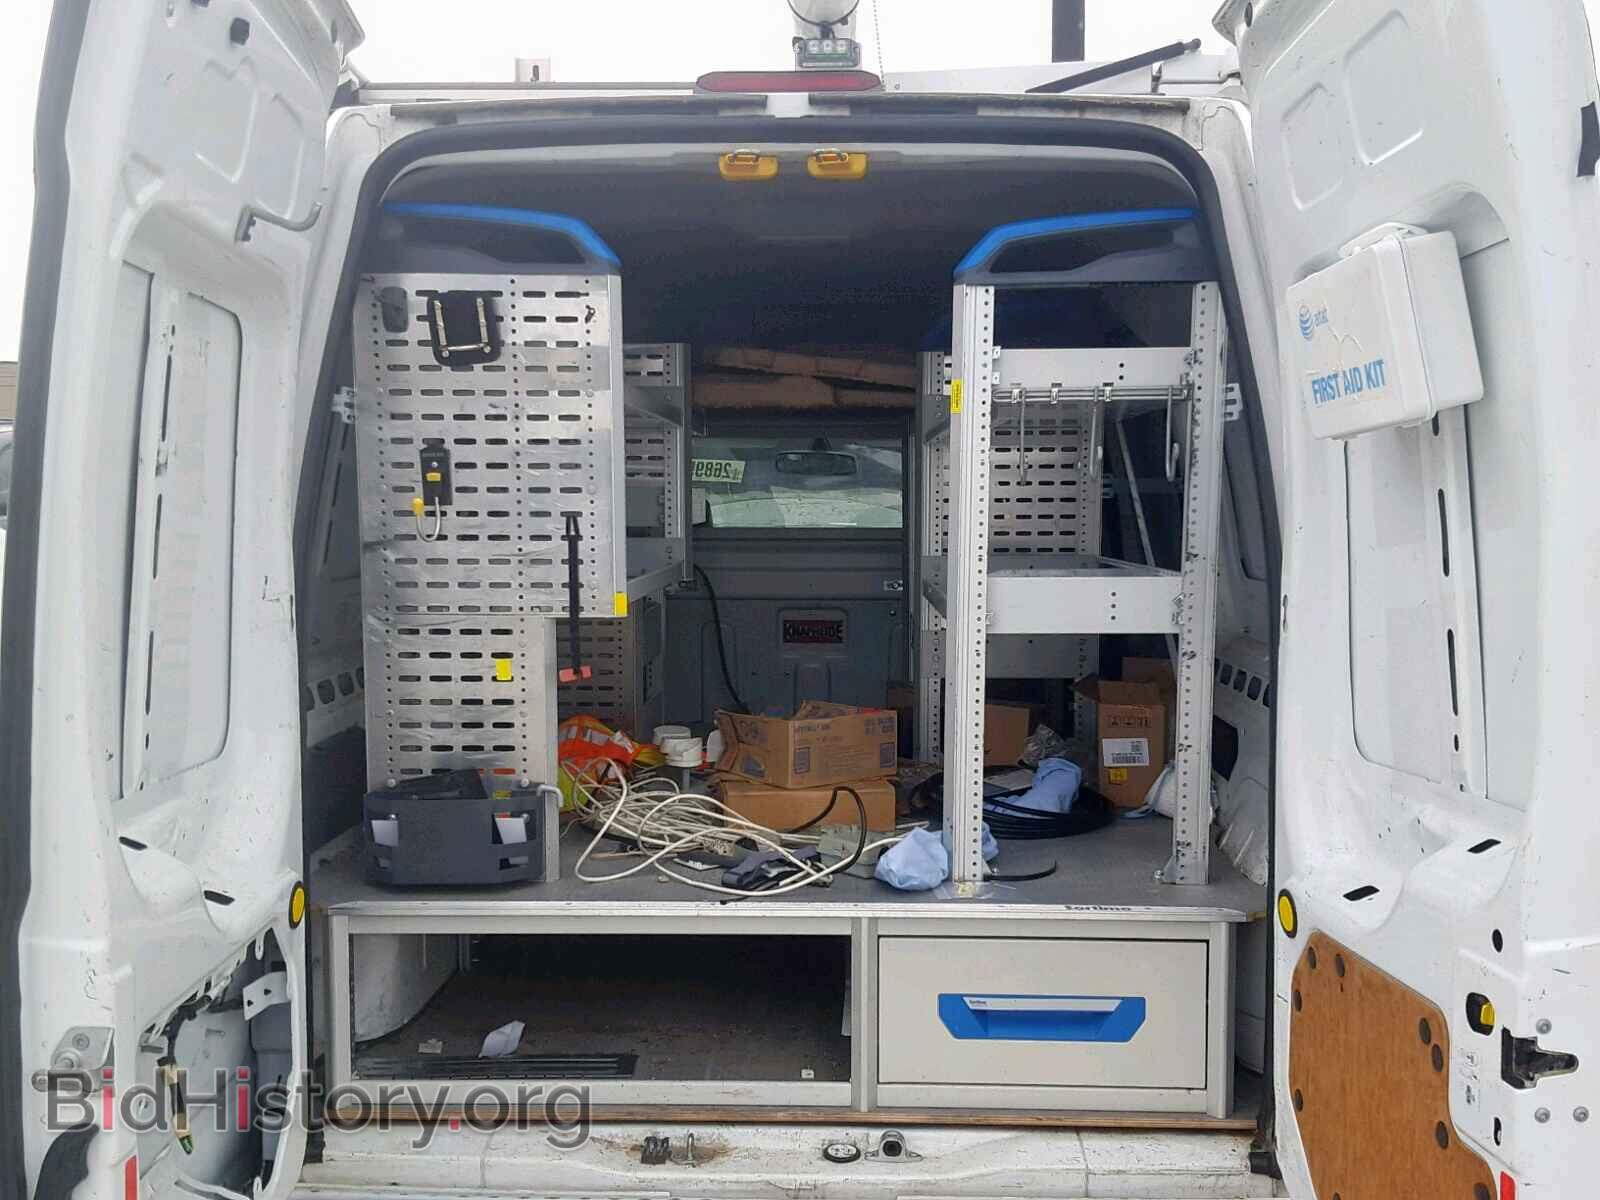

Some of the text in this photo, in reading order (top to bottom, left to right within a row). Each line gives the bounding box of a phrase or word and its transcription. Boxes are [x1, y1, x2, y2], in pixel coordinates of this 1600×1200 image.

[1311, 359, 1387, 405] FIRST AID KIT
